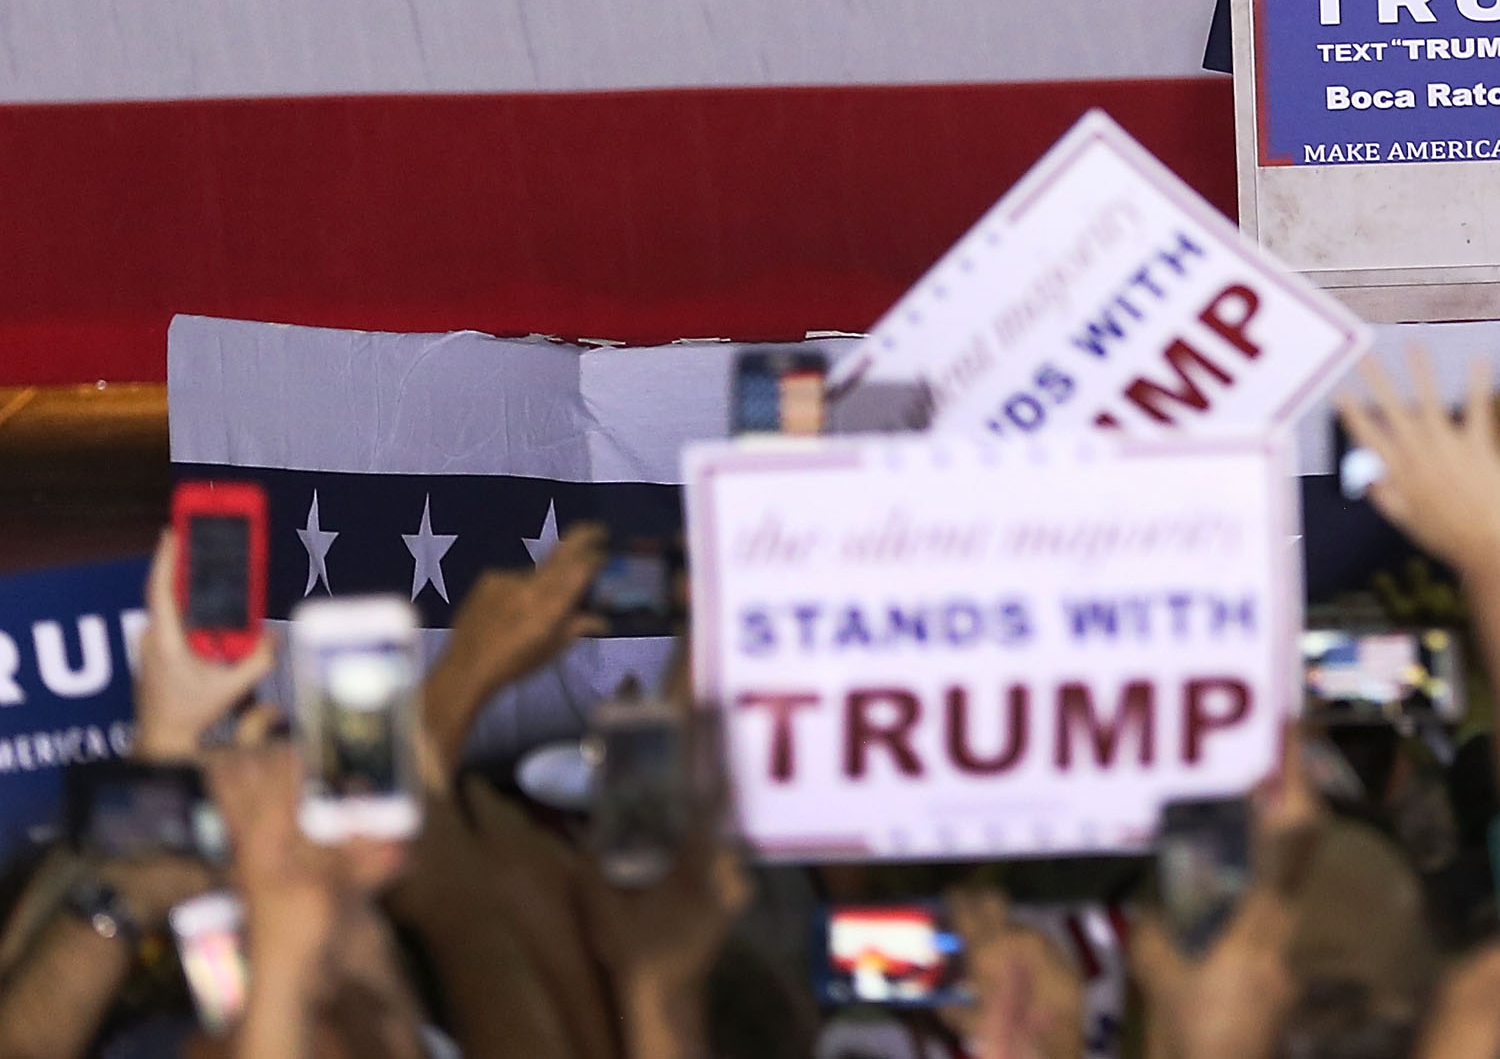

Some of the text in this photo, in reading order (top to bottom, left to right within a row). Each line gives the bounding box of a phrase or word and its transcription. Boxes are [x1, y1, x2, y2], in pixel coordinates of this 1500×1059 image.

[1317, 43, 1388, 63] TEXT
[1326, 83, 1415, 111] Boca
[1303, 143, 1381, 164] MAKE
[1070, 229, 1208, 359] WITH
[738, 588, 1255, 659] STANDS WITH
[733, 674, 1254, 787] TRUMP
